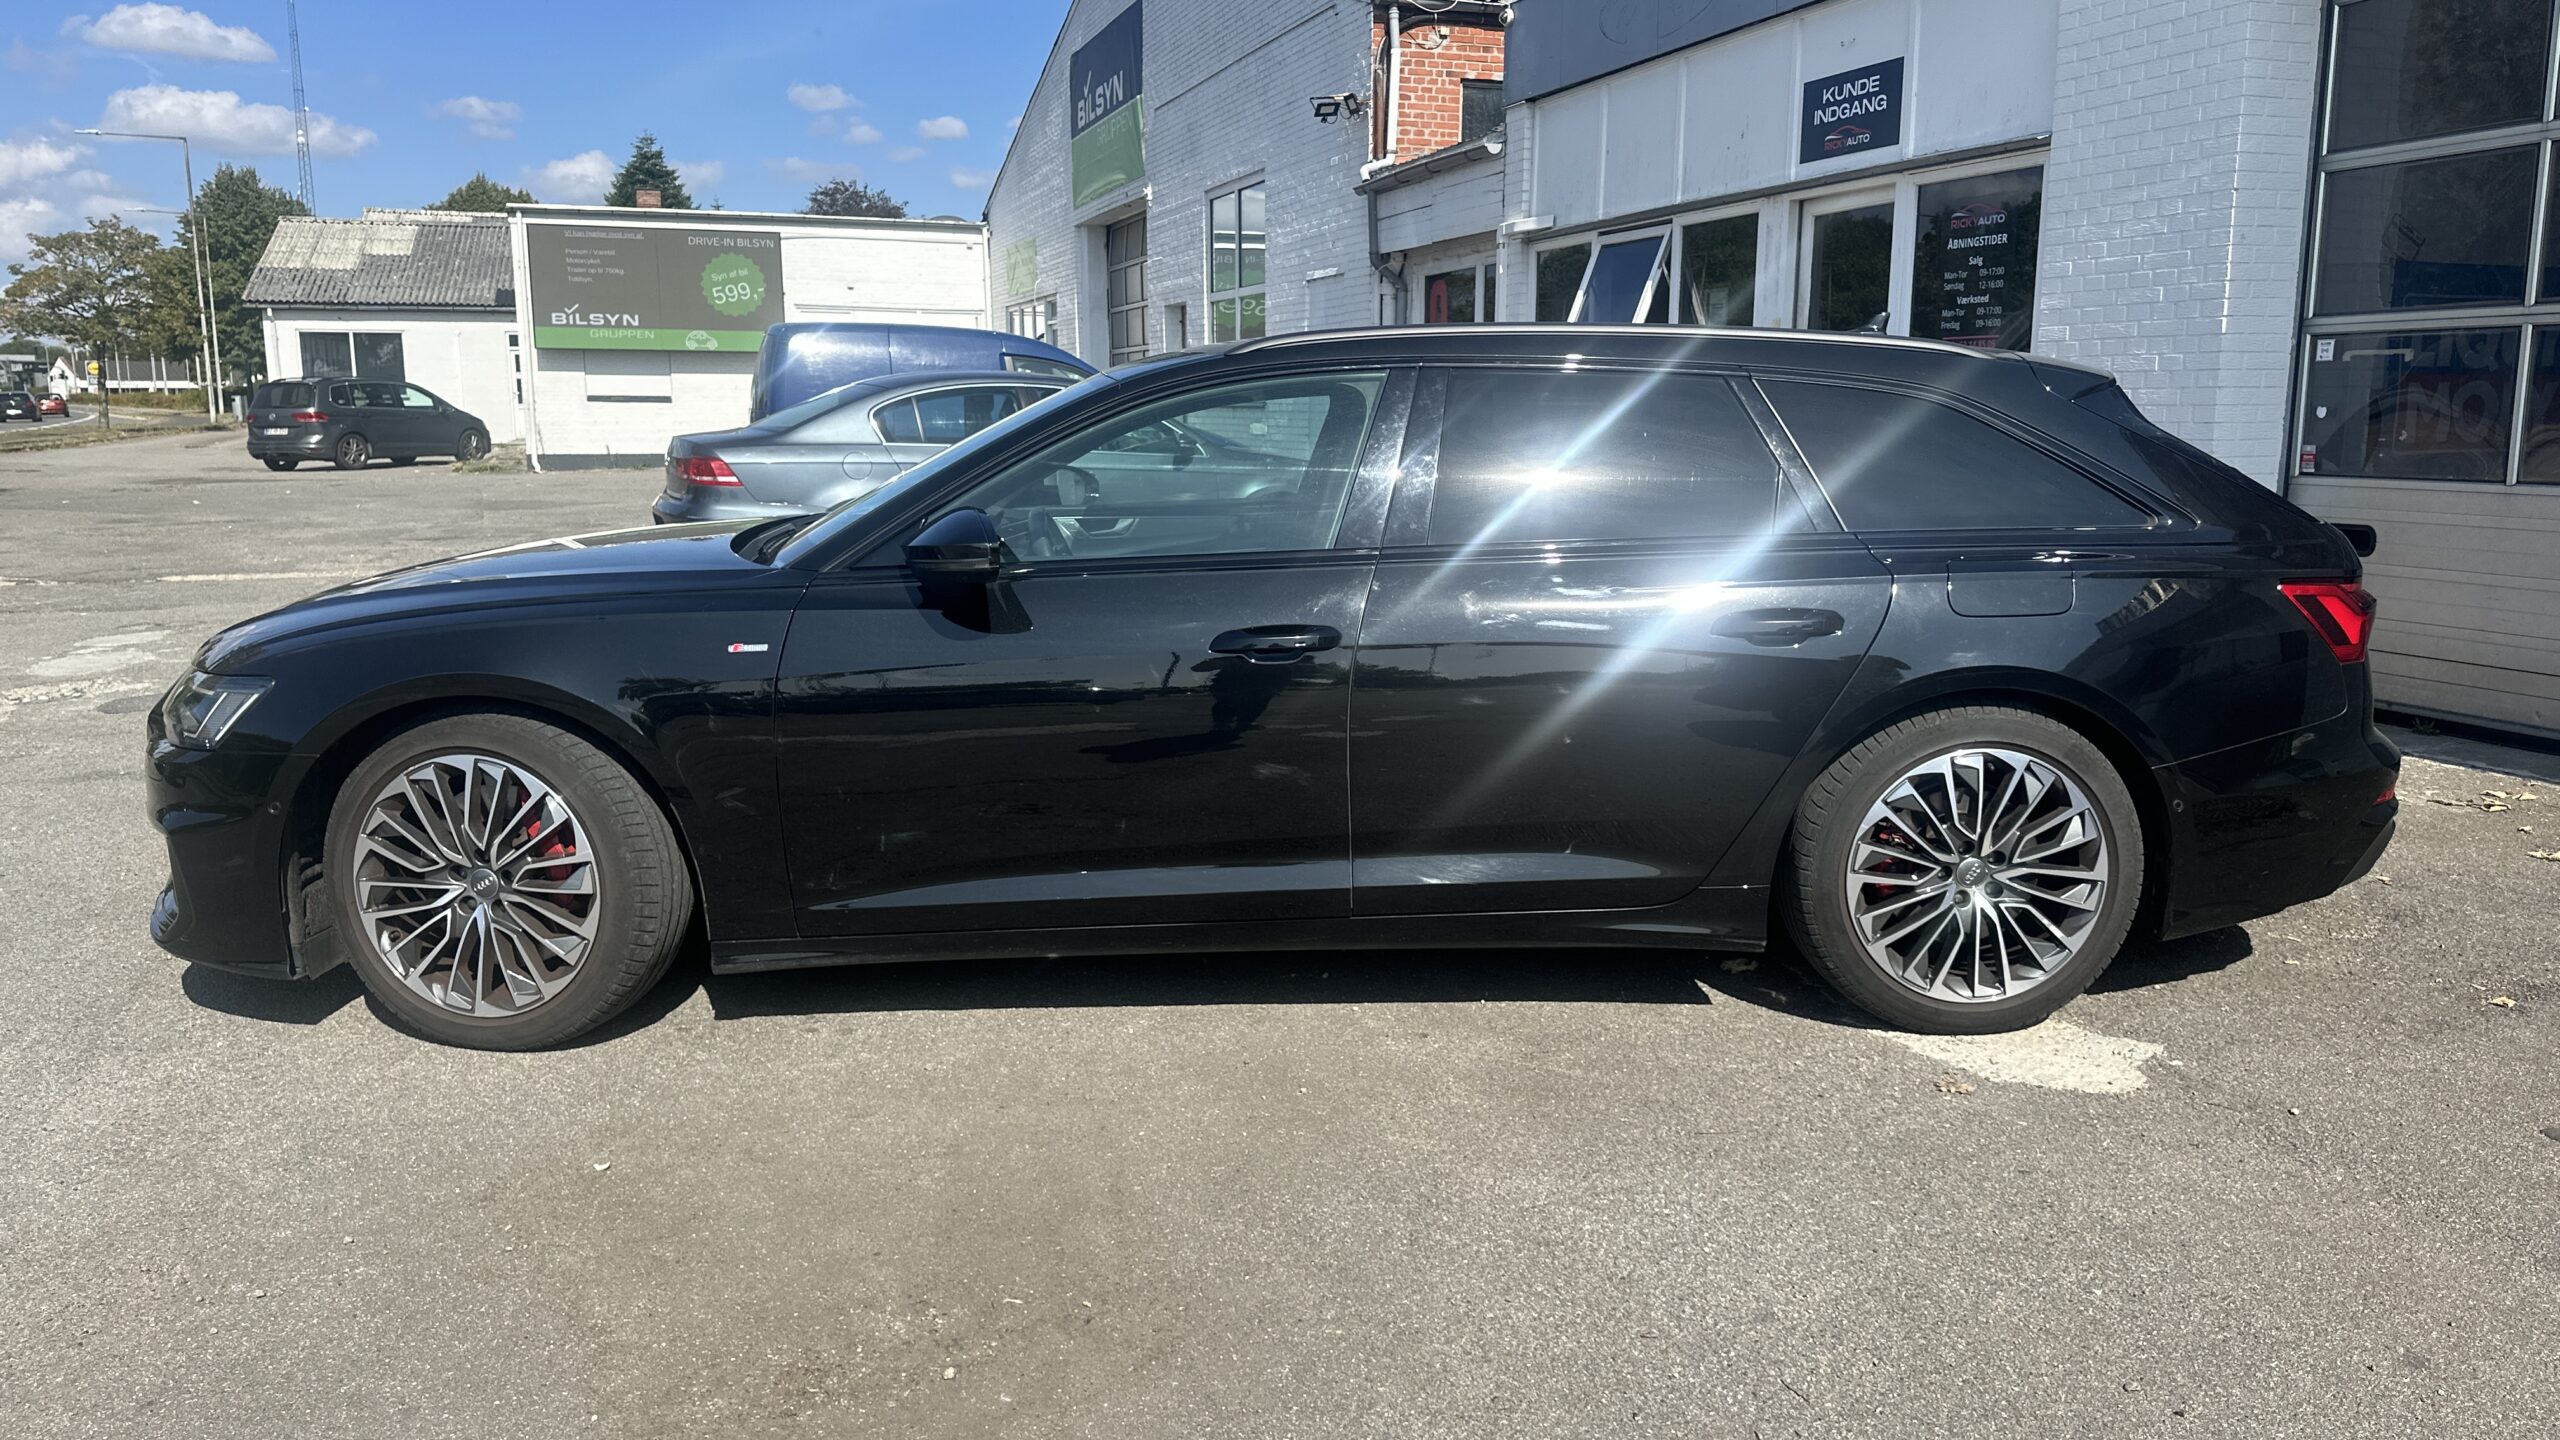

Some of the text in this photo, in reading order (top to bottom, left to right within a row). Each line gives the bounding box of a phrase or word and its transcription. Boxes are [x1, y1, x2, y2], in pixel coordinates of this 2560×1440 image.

[1823, 75, 1880, 104] KUNDE
[1078, 70, 1123, 129] BILSYN
[1814, 94, 1887, 125] INDGANG
[688, 236, 774, 248] DRIVE-IN BILSYN
[1947, 233, 2008, 250] ÅBNINGSTIDER
[1969, 256, 1983, 266] Salg
[711, 273, 727, 282] Syn
[738, 268, 749, 277] bil
[1944, 267, 2005, 280] Man-Tor 09-17:00
[1944, 280, 2004, 291] Søndag 12-16:00
[712, 282, 764, 304] 599,-
[1957, 294, 1990, 305] Værksted
[1941, 306, 2002, 318] Man-Tor 09-17:00
[551, 312, 640, 326] BILSYN
[1941, 319, 2001, 330] Fredag 09-16:00
[589, 328, 655, 339] GRUPPEN
